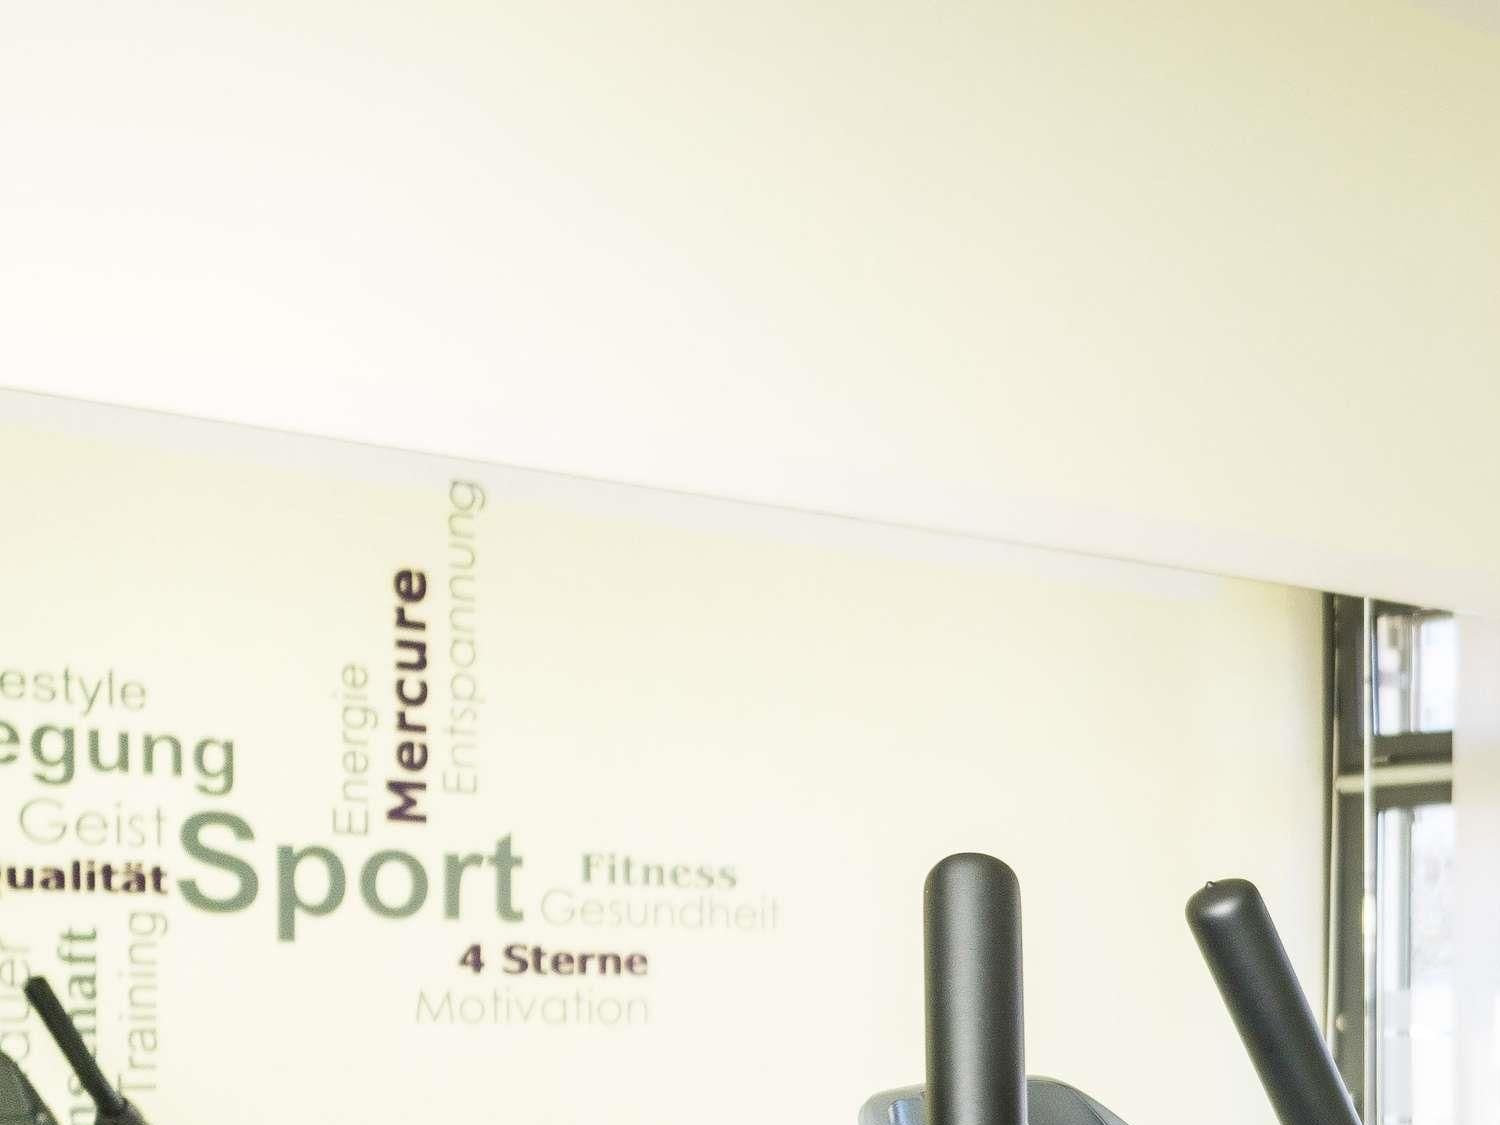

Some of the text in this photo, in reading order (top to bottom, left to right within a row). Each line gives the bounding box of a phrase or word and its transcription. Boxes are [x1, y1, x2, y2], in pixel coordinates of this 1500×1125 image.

[443, 478, 486, 795] Entspannung
[386, 568, 429, 824] Mercure
[332, 662, 378, 836] Energie
[17, 796, 165, 847] Geist
[0, 858, 167, 896] ualität
[177, 811, 524, 943] Sport
[581, 852, 738, 889] Fitness
[539, 888, 780, 930] Gesundheit
[458, 943, 649, 976] 4 Sterne
[414, 987, 650, 1026] Motivation
